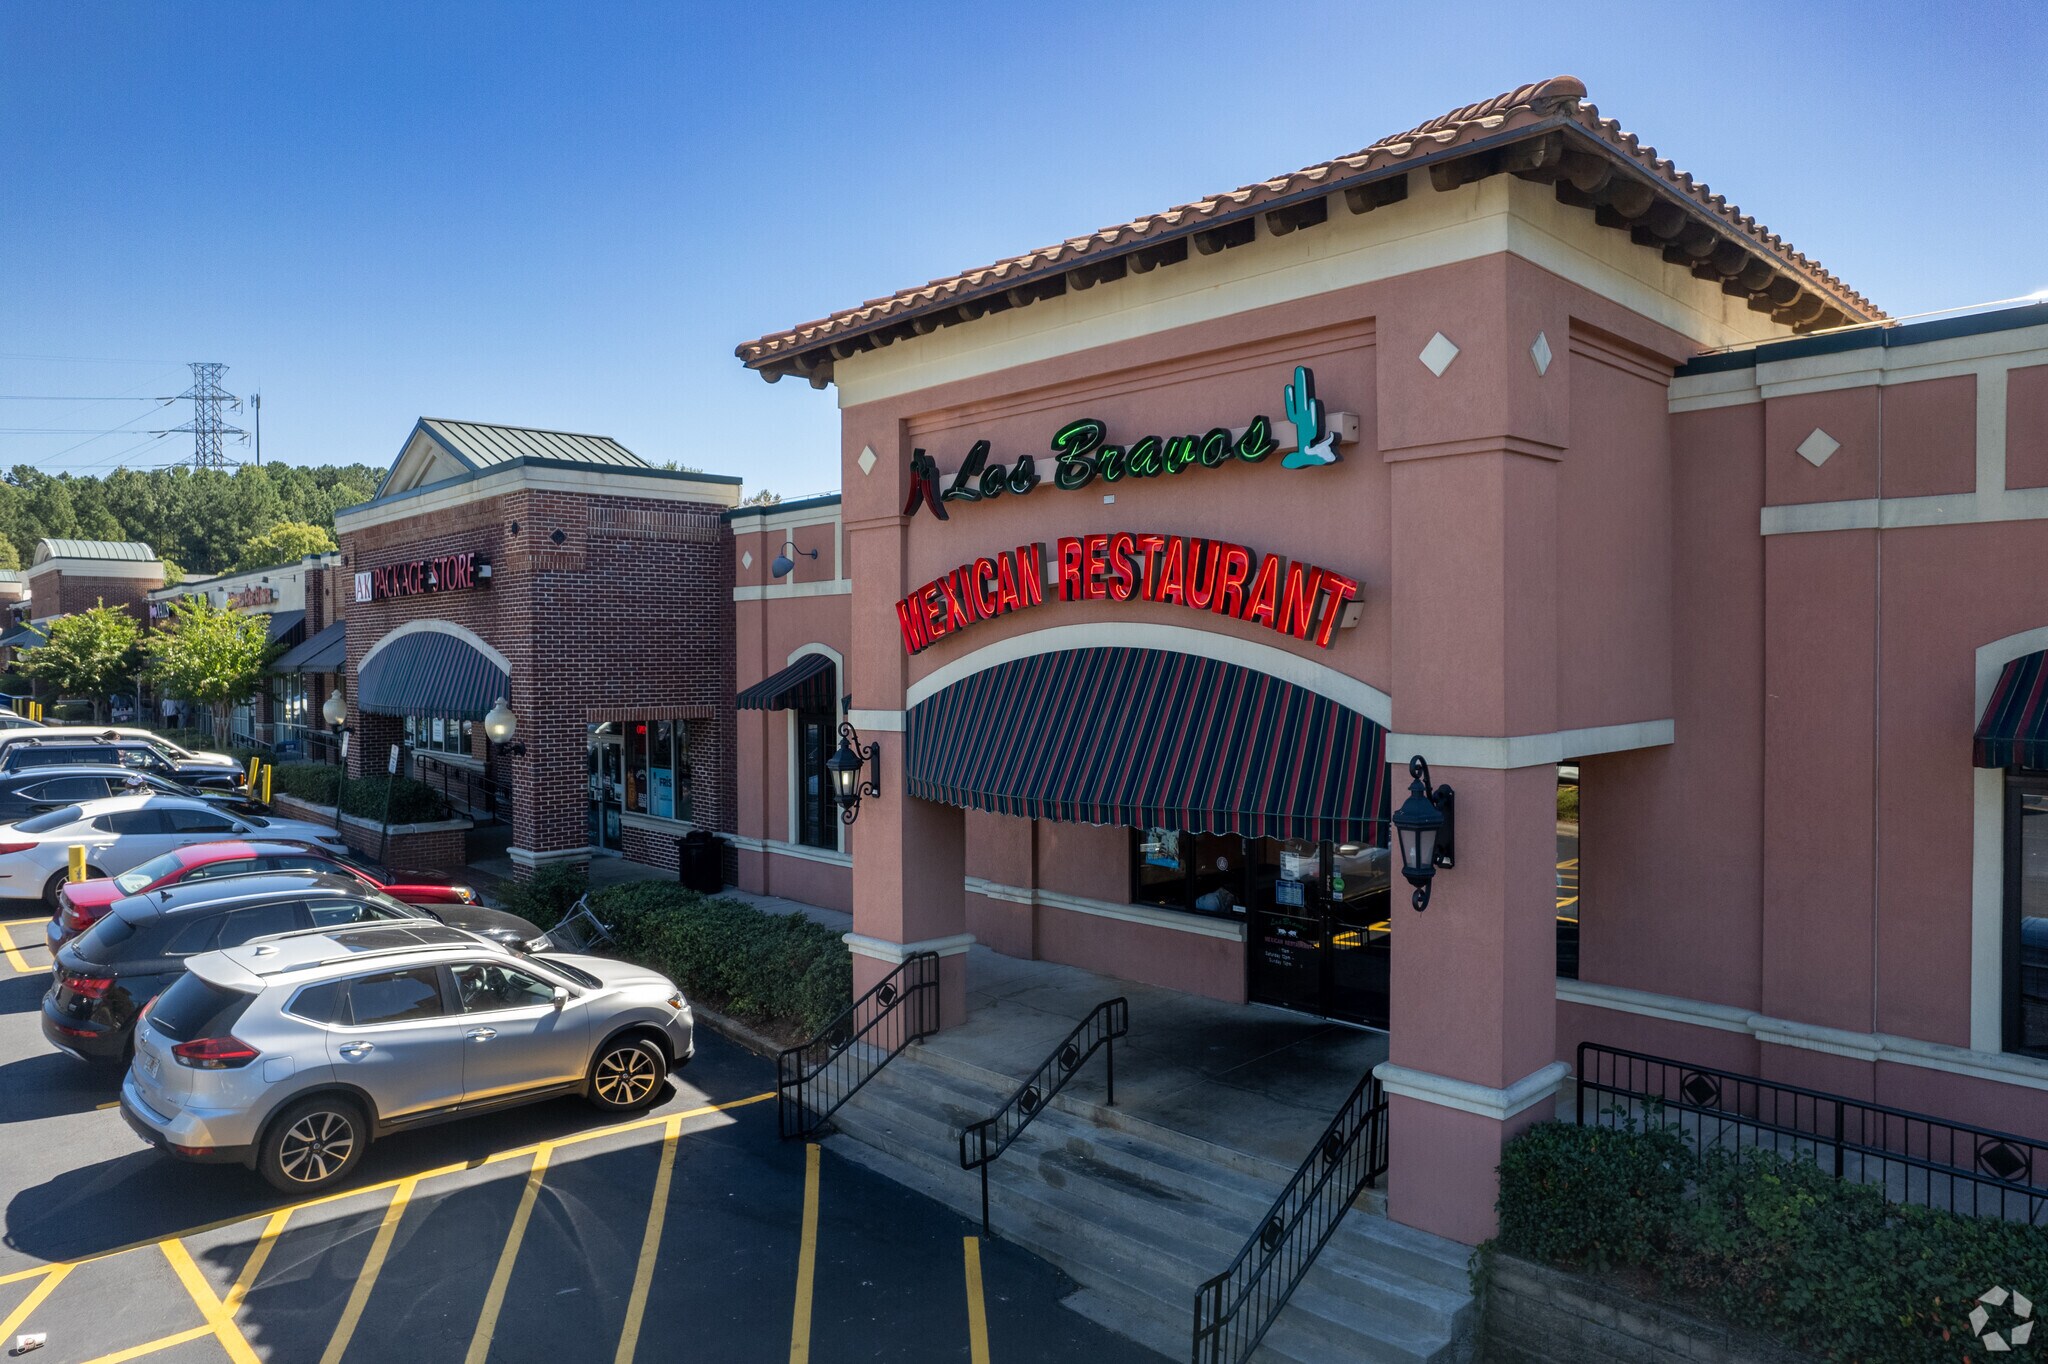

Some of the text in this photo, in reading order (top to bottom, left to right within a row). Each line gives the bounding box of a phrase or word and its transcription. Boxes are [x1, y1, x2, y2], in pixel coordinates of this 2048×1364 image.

[942, 416, 1278, 501] Los Bravos
[374, 561, 425, 599] PACKAGE
[431, 552, 476, 592] STORE
[896, 533, 1364, 655] MEXICAN RESTAURANT
